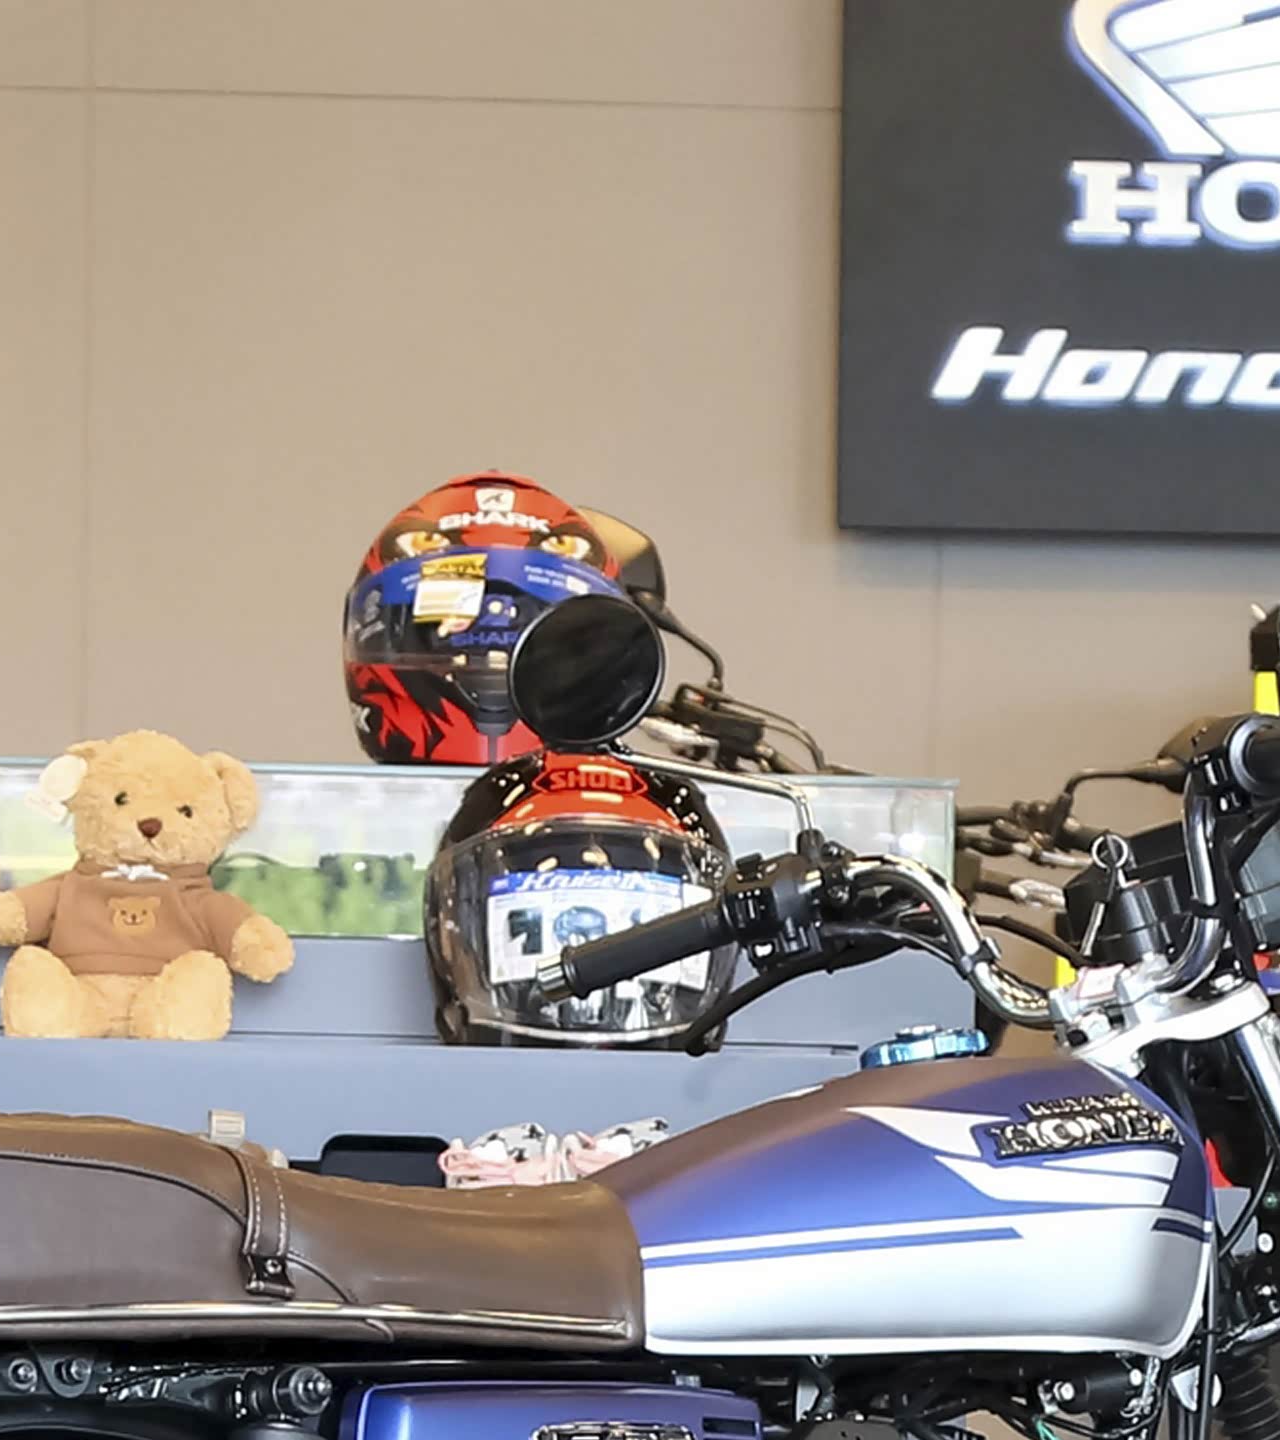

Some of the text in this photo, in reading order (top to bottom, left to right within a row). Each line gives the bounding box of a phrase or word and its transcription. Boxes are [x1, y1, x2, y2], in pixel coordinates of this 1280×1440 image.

[438, 511, 552, 534] SHARK
[451, 630, 519, 647] SHAR
[548, 769, 634, 792] SHOEI
[988, 1108, 1186, 1156] HONDA
